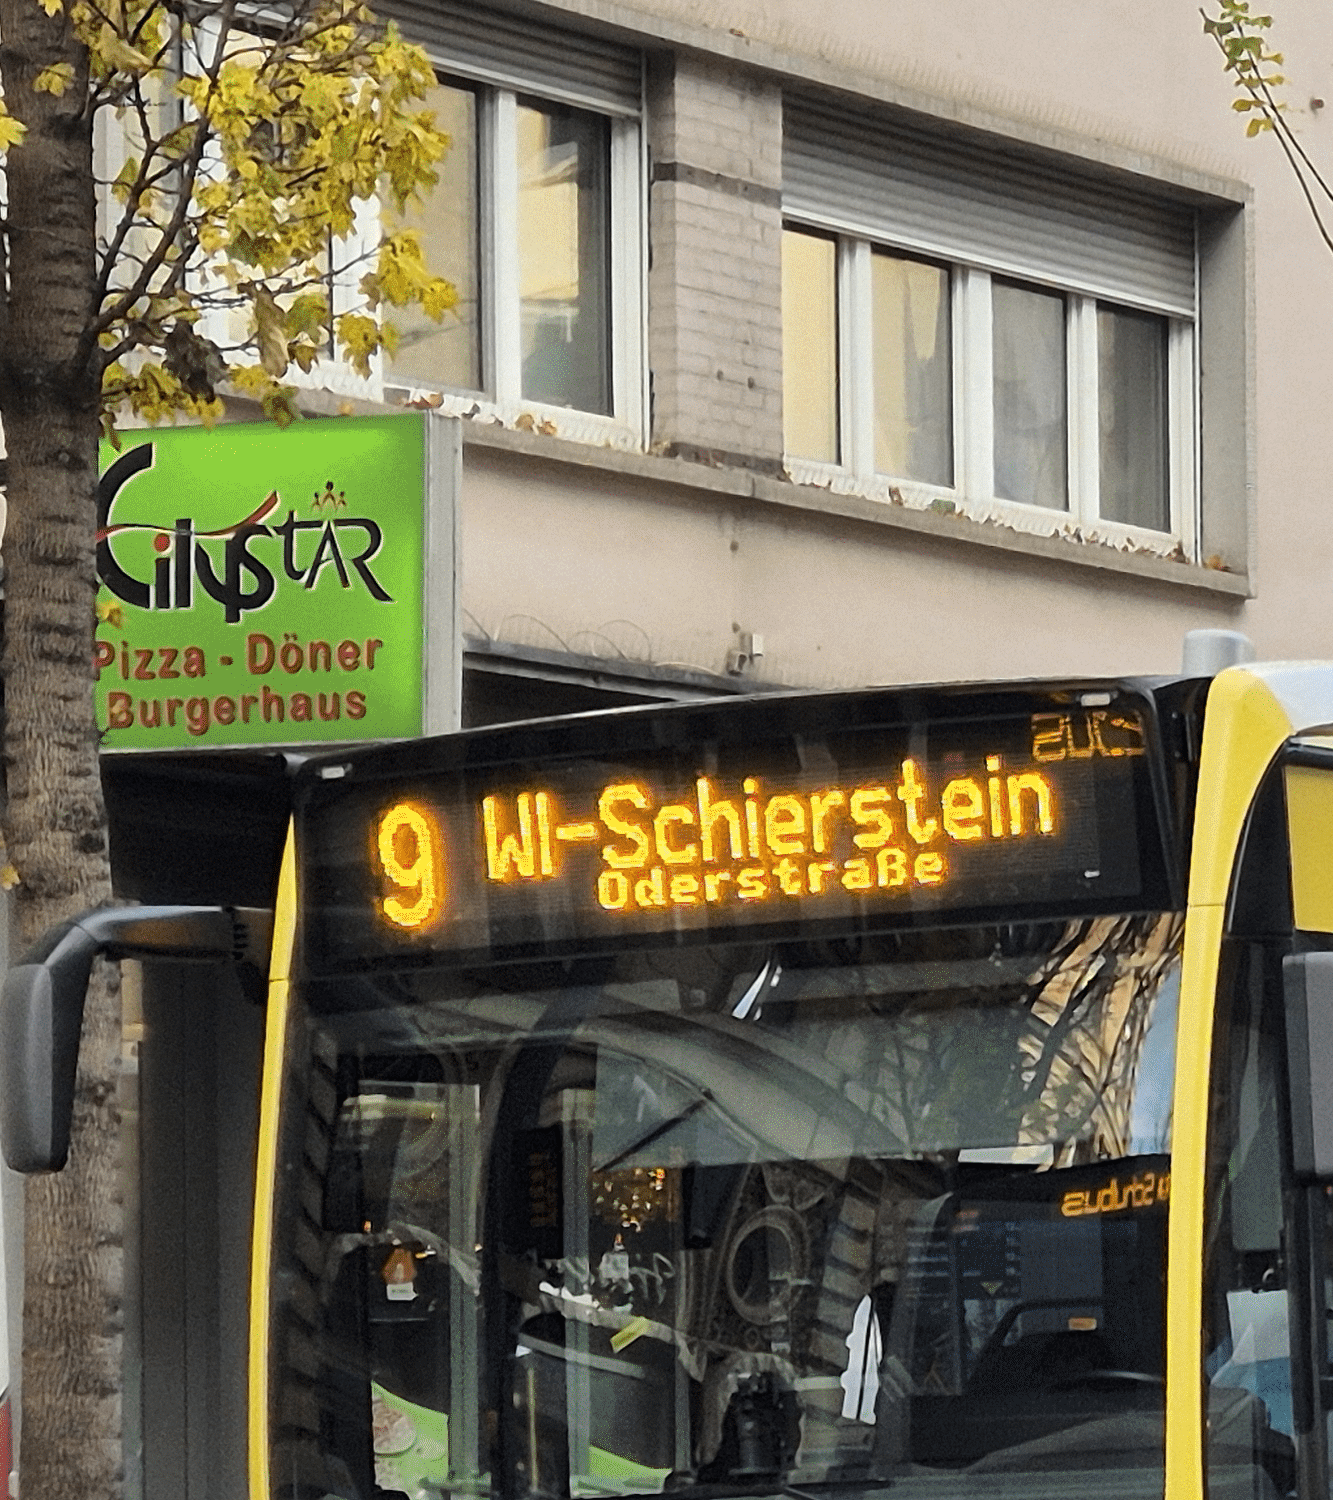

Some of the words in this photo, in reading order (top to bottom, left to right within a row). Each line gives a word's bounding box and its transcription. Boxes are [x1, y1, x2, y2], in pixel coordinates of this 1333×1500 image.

[95, 640, 206, 682] Pizza
[246, 631, 383, 676] Döner
[107, 685, 368, 736] Burgerhaus
[378, 803, 439, 927] 9
[482, 756, 1054, 881] WI-Schierstein
[598, 846, 946, 910] Oderstraße
